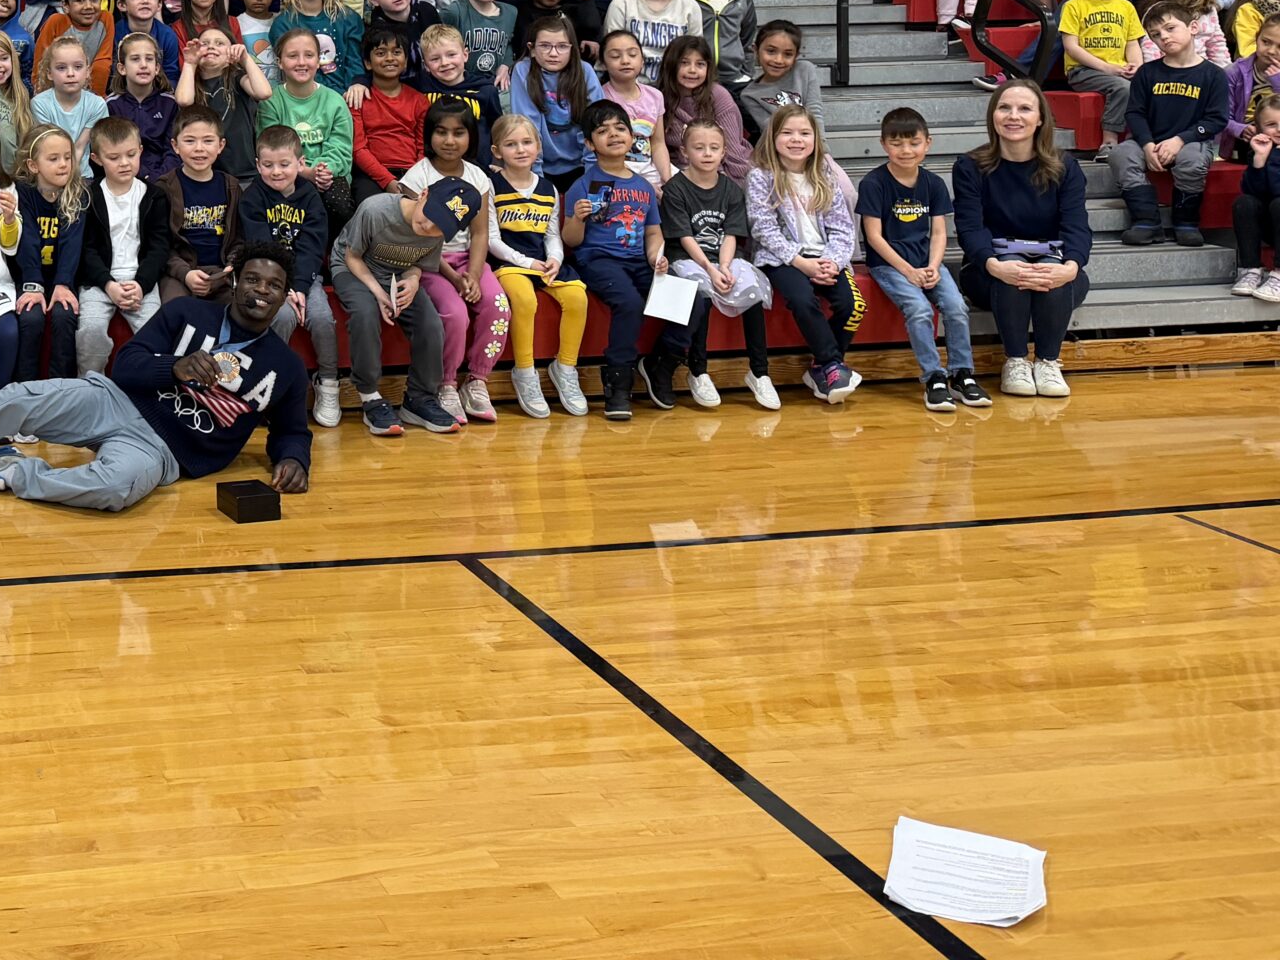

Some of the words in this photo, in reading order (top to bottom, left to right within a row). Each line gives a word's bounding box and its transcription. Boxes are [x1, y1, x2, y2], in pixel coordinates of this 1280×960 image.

[1083, 10, 1125, 29] MICHIGAN
[1084, 36, 1122, 49] BASKETBAL
[1152, 82, 1202, 100] MICHIGAN
[500, 208, 551, 228] Michiga
